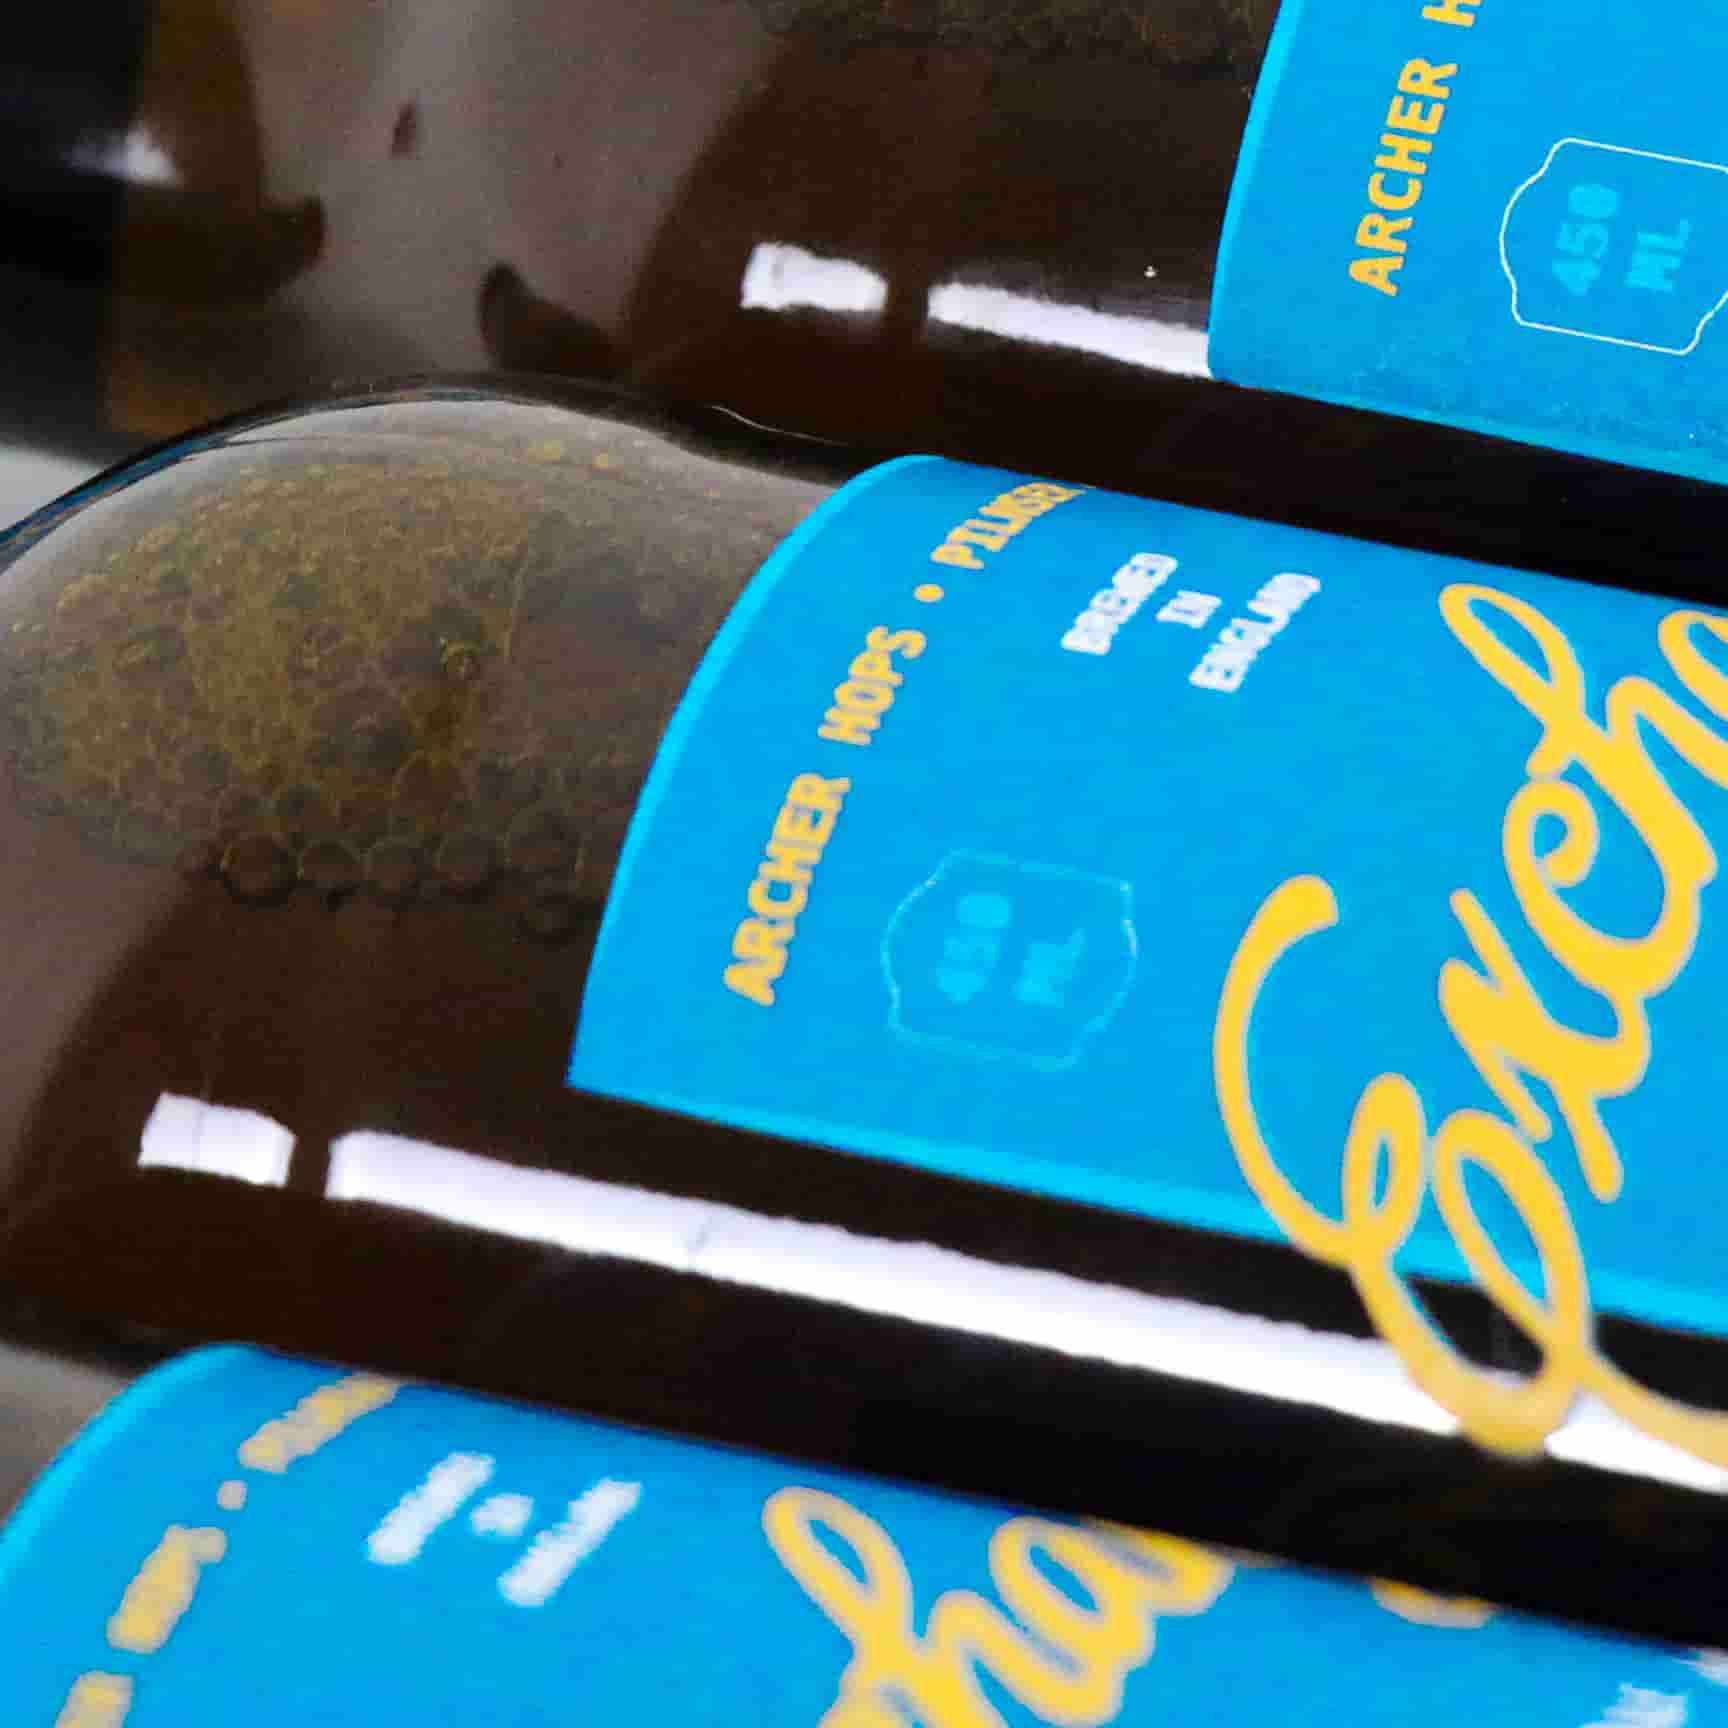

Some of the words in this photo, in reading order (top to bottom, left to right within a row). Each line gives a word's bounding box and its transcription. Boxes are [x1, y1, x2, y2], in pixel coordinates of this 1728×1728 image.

[1349, 58, 1458, 297] ARCHER
[725, 773, 850, 1006] ARCHER
[818, 625, 927, 746] HOPS
